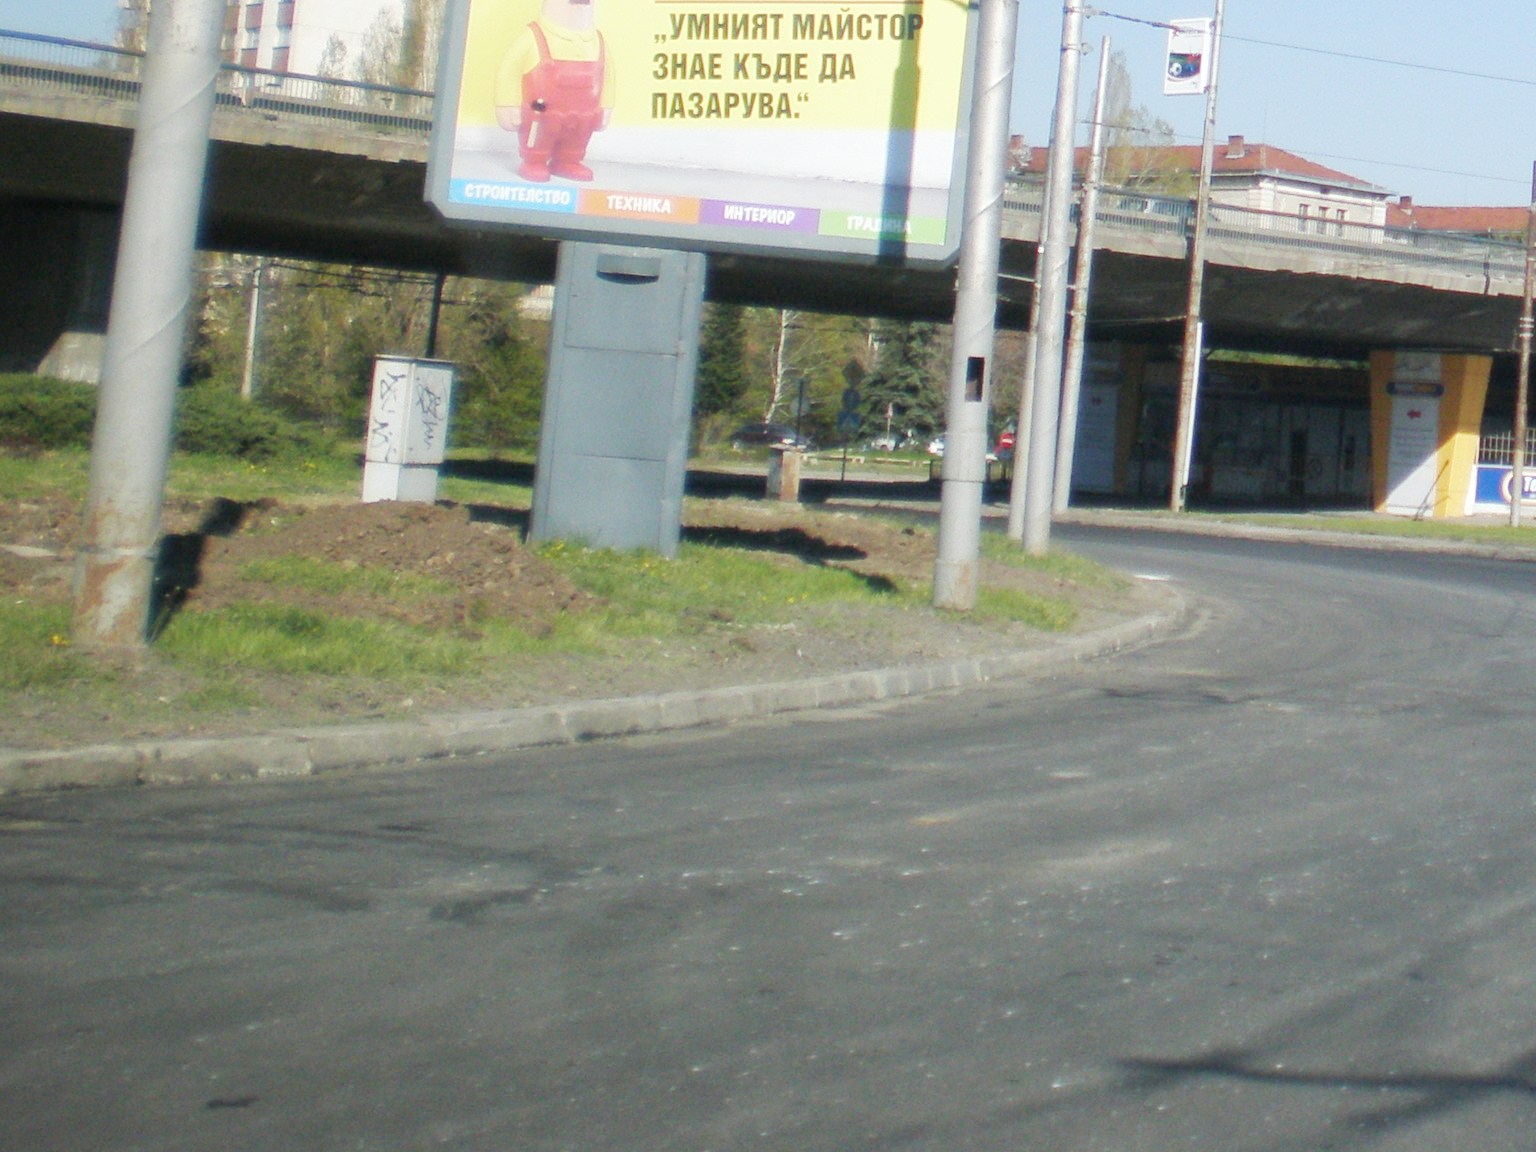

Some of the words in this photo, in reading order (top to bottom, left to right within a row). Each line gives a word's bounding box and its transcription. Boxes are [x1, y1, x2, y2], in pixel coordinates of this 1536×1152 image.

[791, 7, 924, 41] МАЙСТОР
[652, 53, 722, 80] ЗНАЕ
[733, 53, 809, 83] КЪДЕ
[818, 53, 856, 83] ДА
[464, 183, 570, 206] СТРОИТЕЛСТВО
[606, 195, 672, 214] ТЕХНИКА
[724, 205, 796, 226] ИНТЕРИОР
